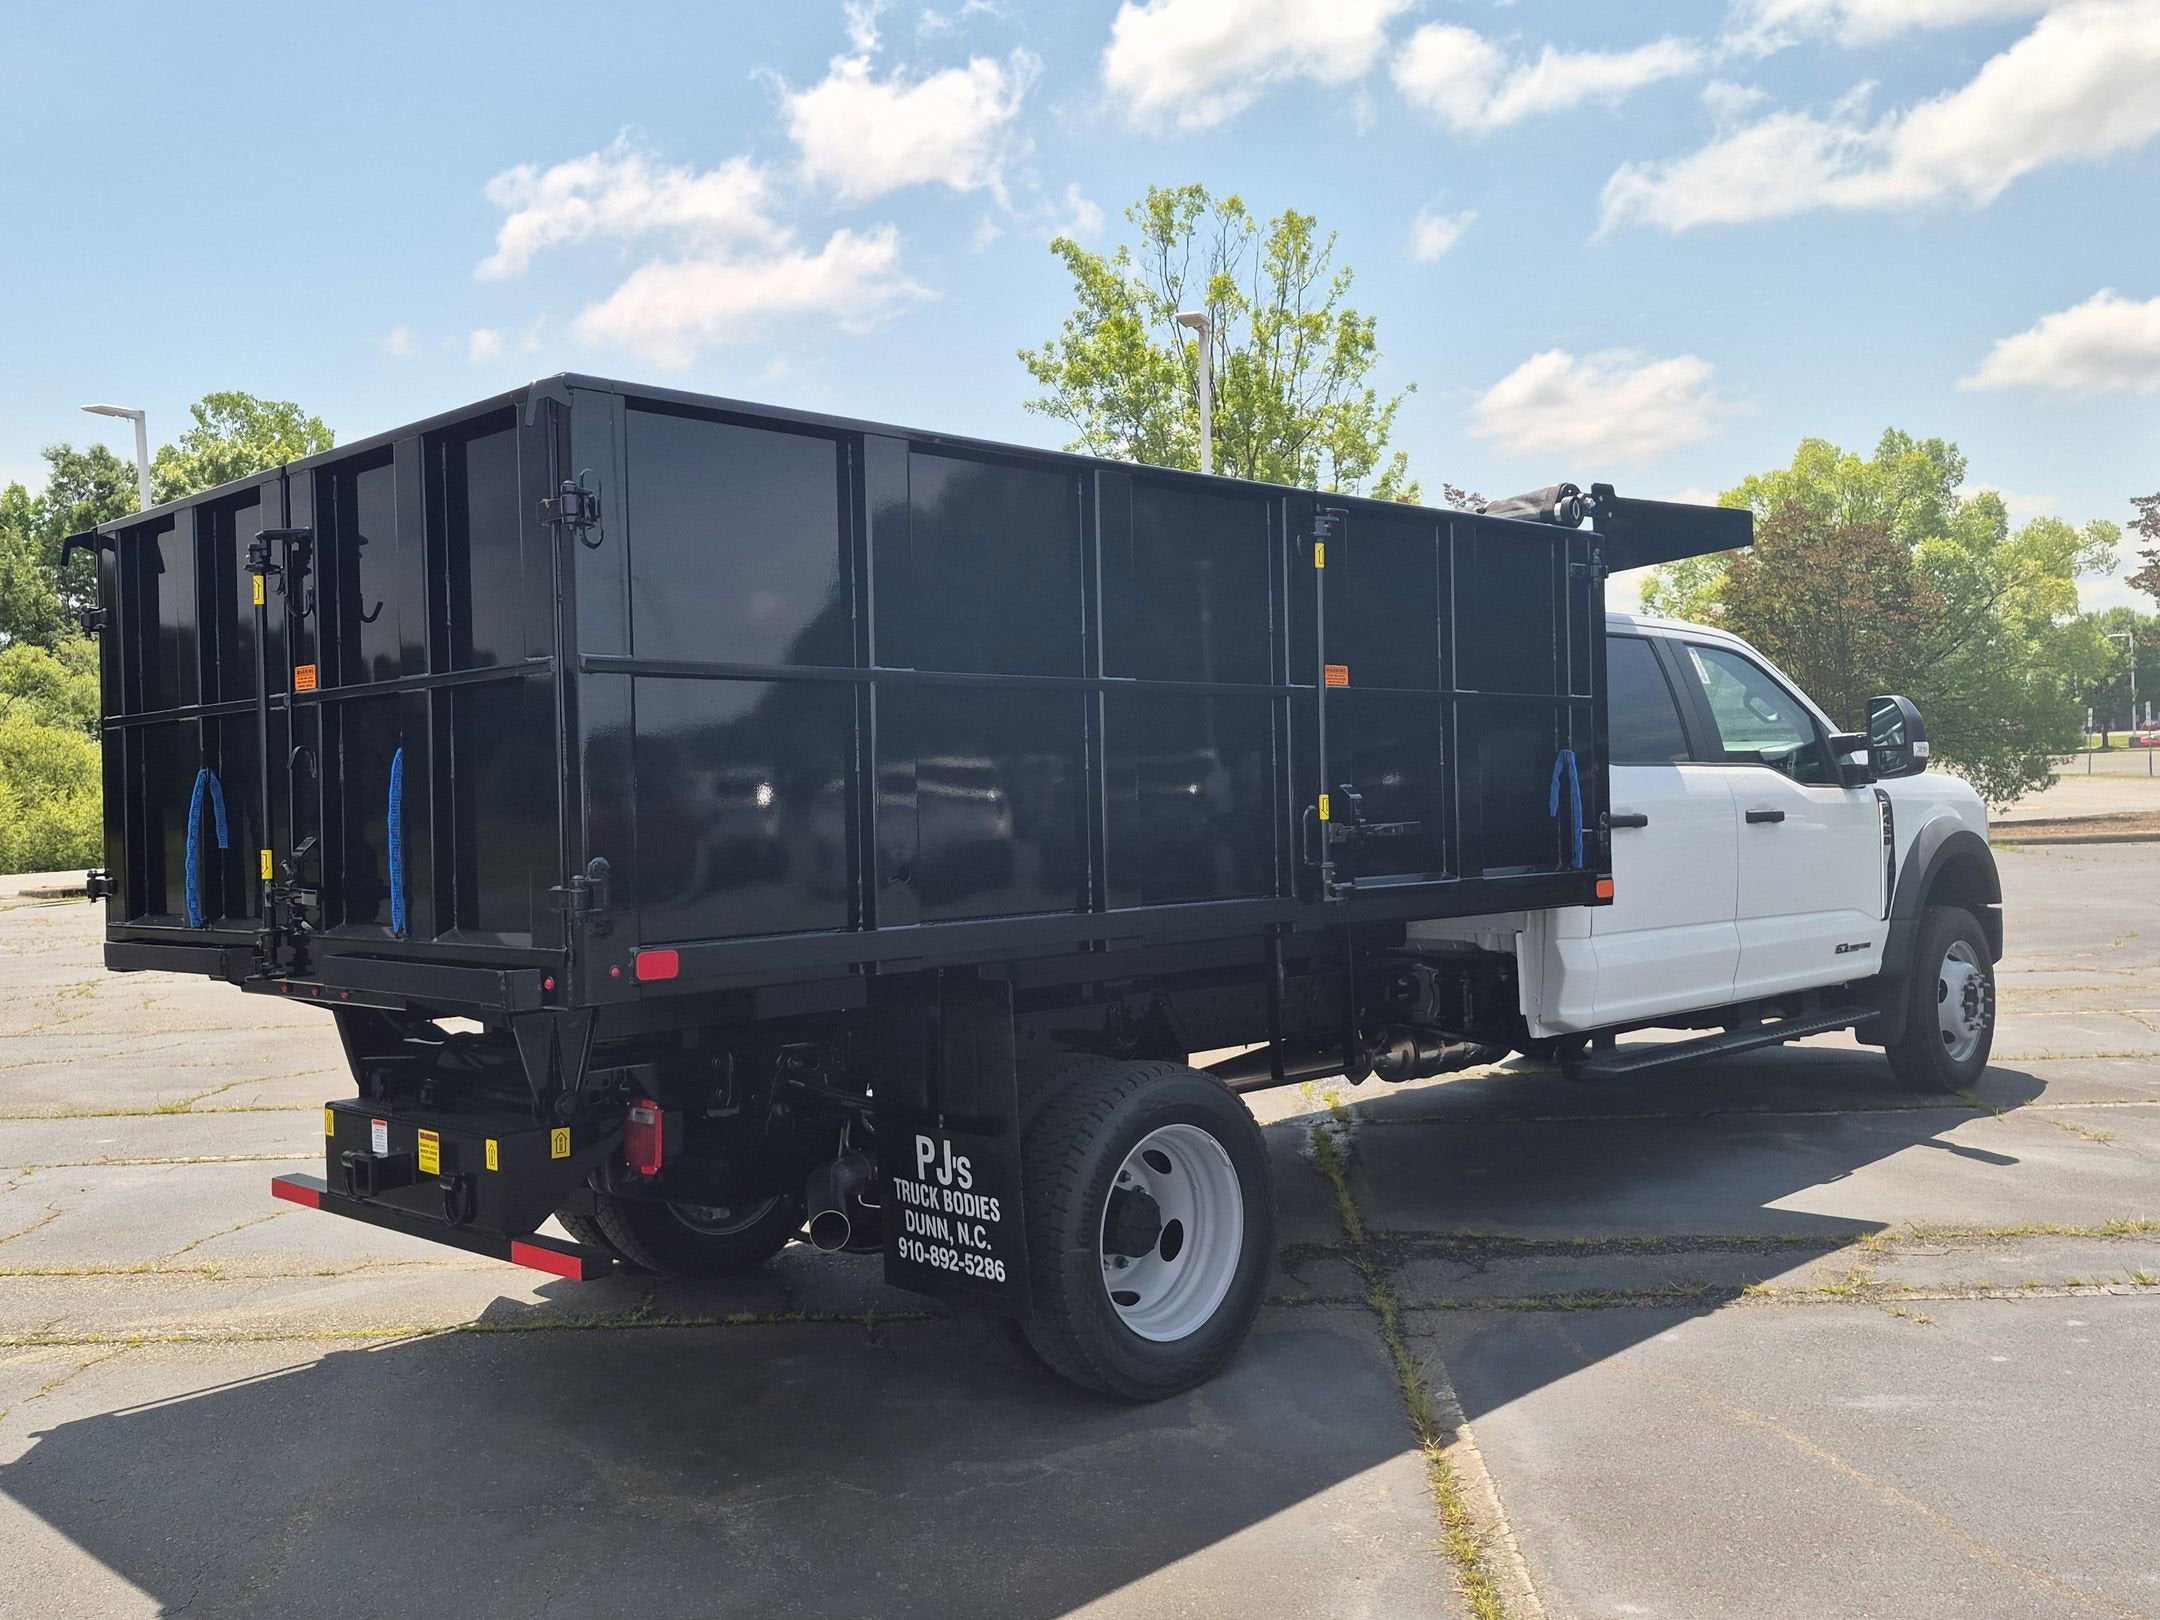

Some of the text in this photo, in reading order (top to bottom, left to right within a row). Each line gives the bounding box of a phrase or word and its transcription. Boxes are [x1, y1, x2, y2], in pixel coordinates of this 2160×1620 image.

[915, 1134, 973, 1190] PJ's
[893, 1177, 1001, 1222] TRUCK BODIES
[904, 1208, 992, 1251] DUNN, N.C.
[898, 1236, 1006, 1283] 910-892-5286
